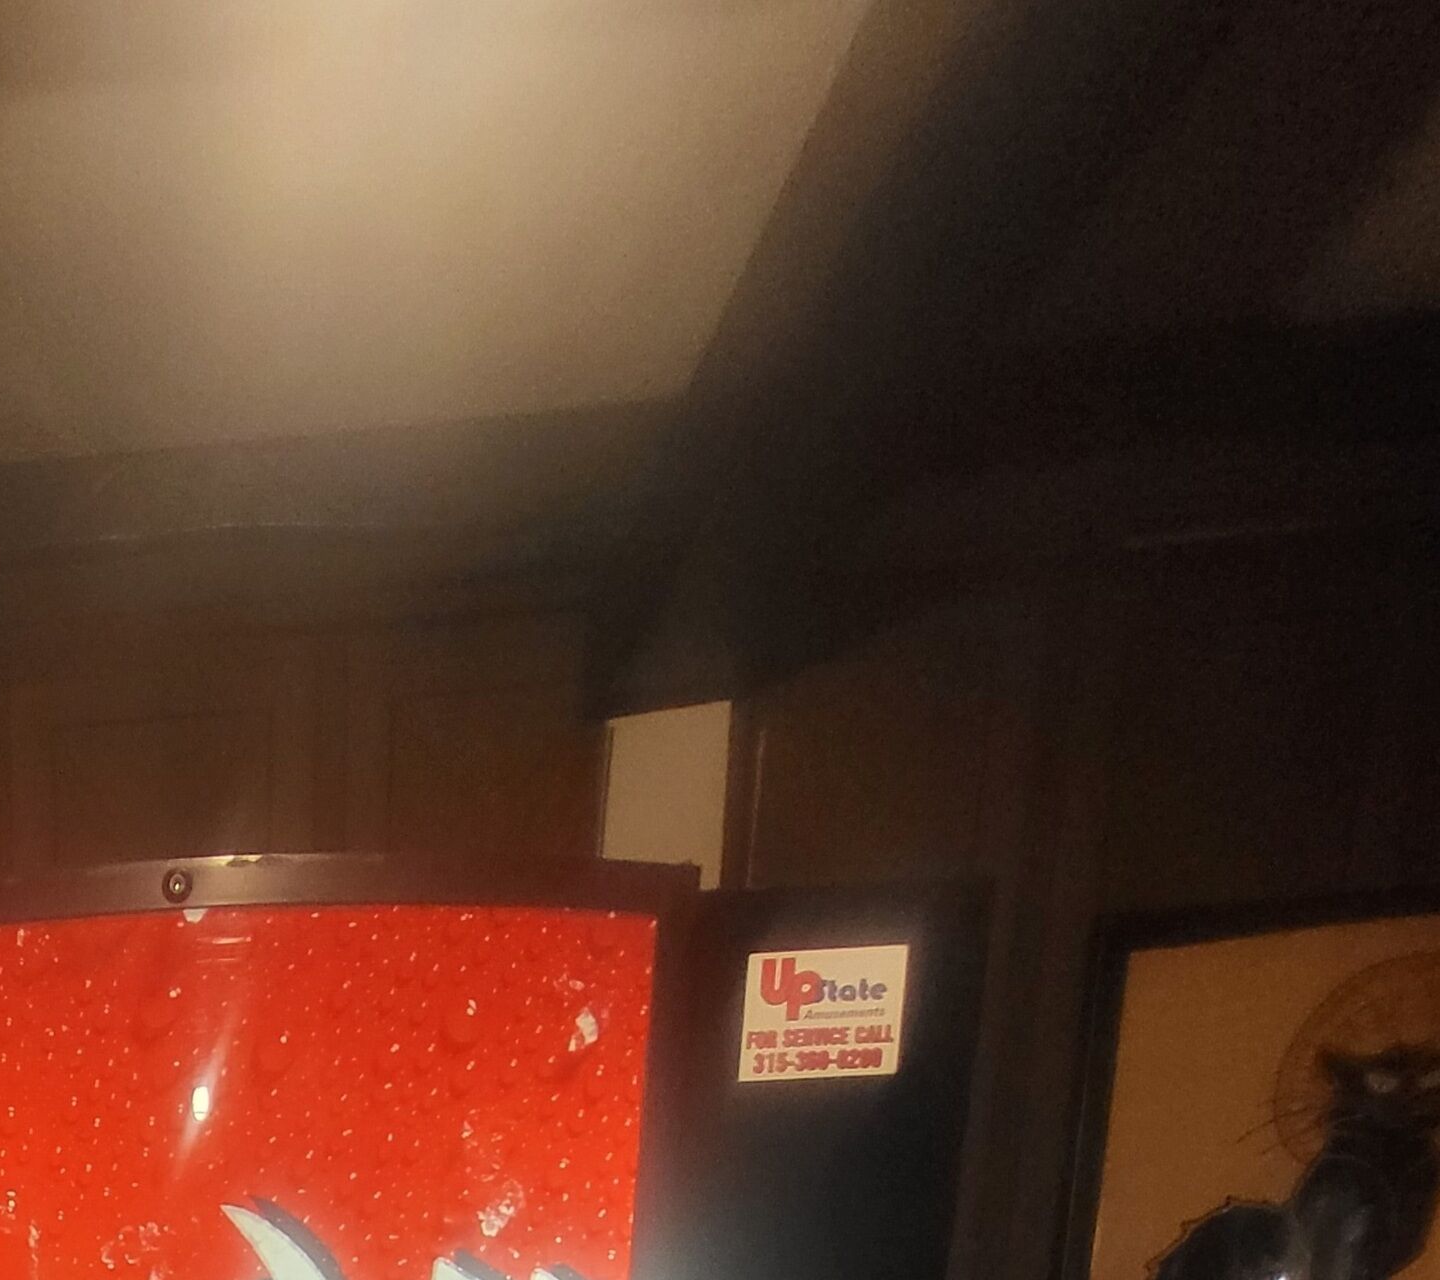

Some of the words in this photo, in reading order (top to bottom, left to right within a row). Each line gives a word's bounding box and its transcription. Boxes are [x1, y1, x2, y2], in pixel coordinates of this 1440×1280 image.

[746, 1030, 778, 1050] FOR
[782, 1026, 850, 1048] SERVICE
[854, 1024, 895, 1044] CALL
